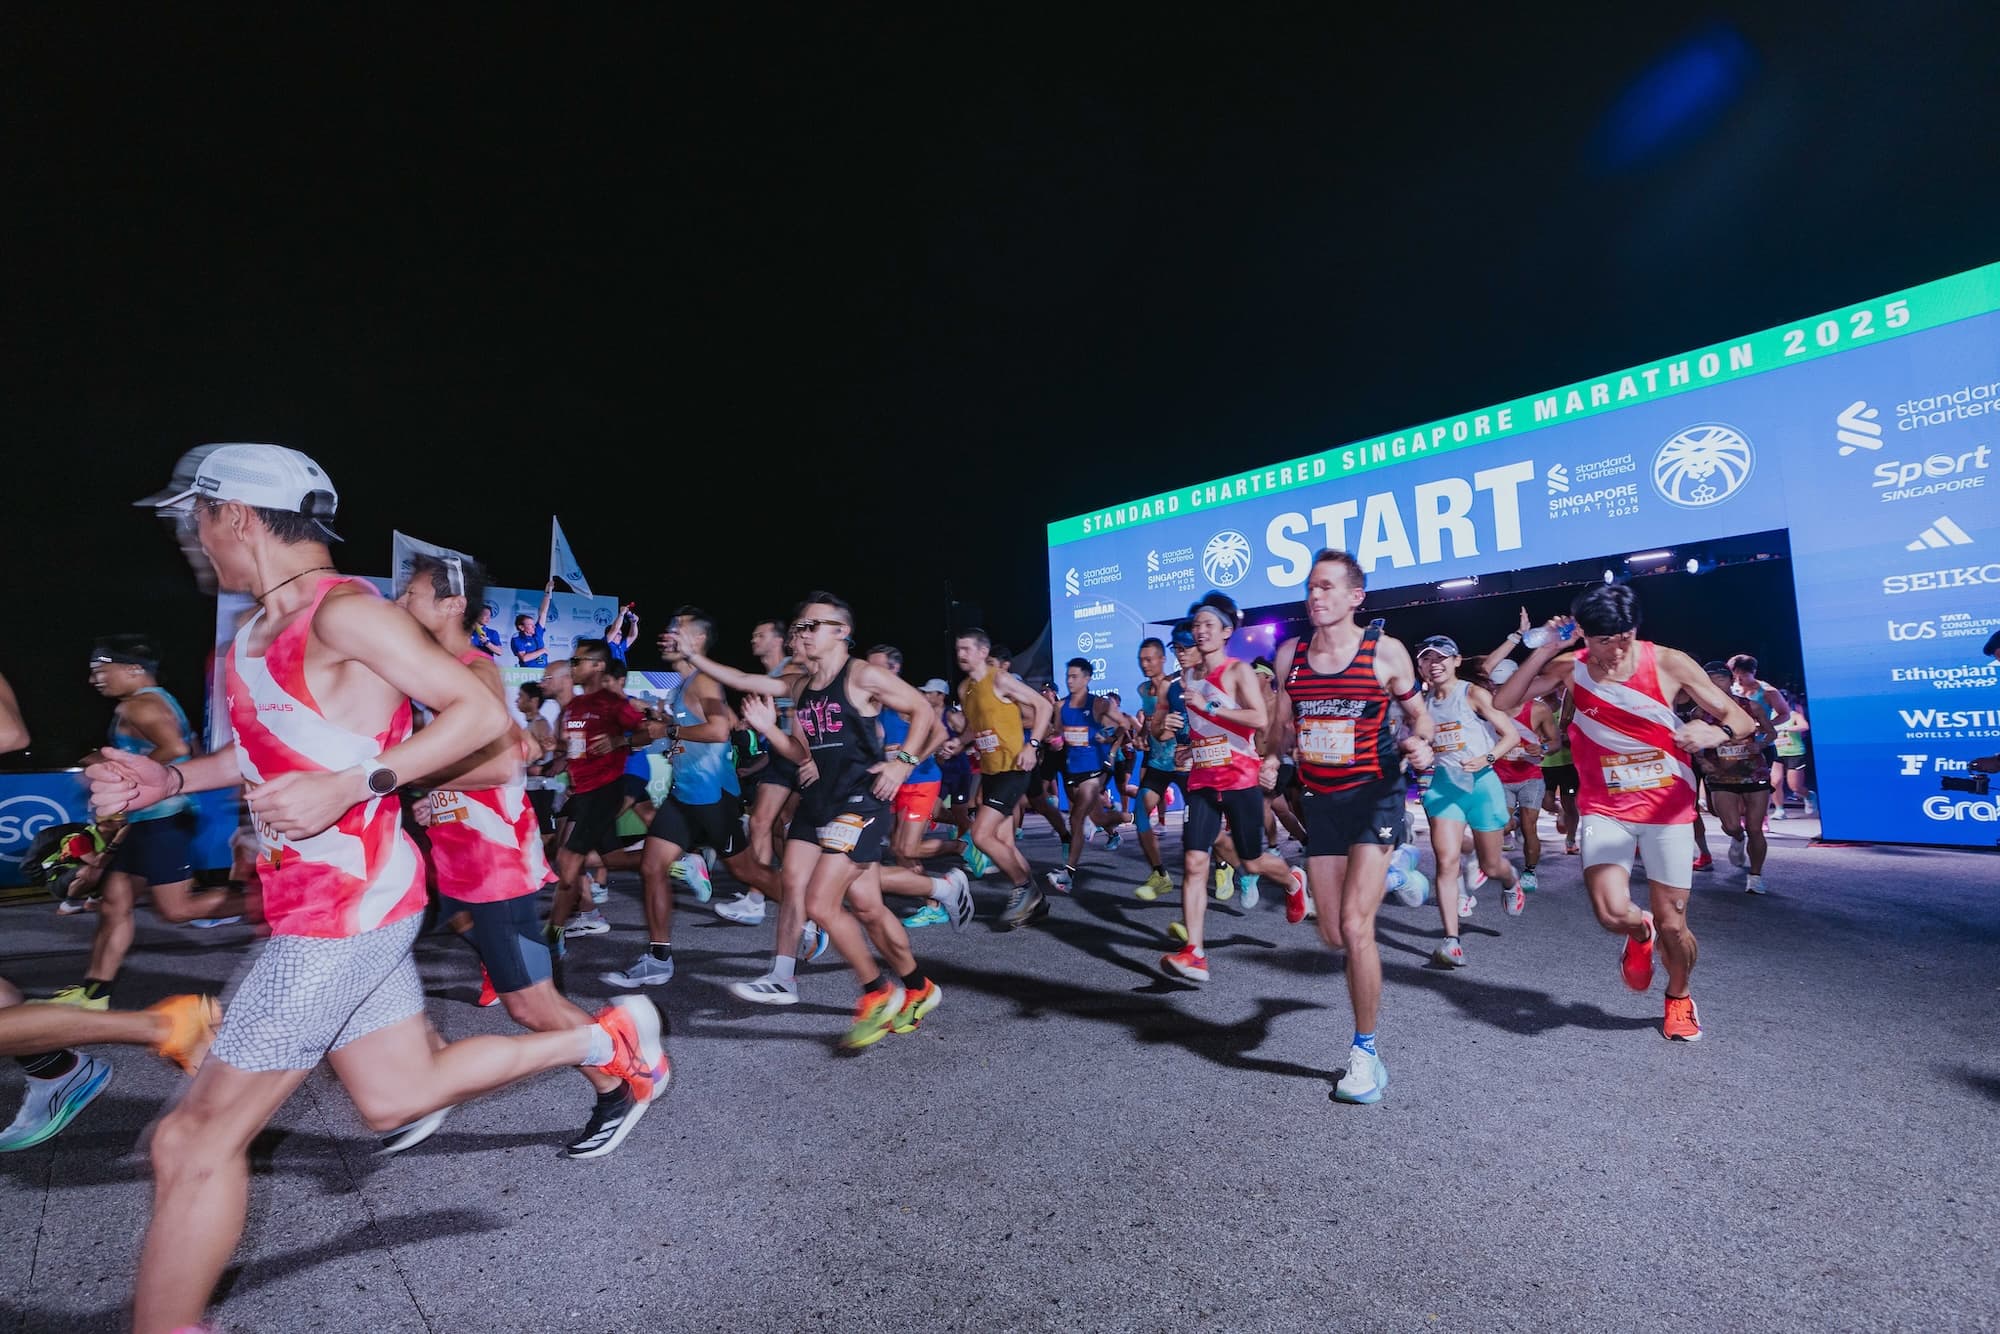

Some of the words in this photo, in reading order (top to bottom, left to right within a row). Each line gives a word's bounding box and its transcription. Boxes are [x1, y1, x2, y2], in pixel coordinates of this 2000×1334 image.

[1082, 493, 1180, 534] STANDARD
[1191, 458, 1328, 507] CHARTERED
[1342, 408, 1514, 471] SINGAPORE
[1533, 342, 1754, 423] MARATHON
[1783, 300, 1911, 357] 2025
[1575, 453, 1632, 474] standard
[1575, 462, 1636, 482] chartered
[1872, 444, 1991, 488] Sport
[1549, 483, 1638, 511] SINGAPORE
[1880, 475, 1985, 503] SINGAPORE
[1549, 496, 1639, 520] MARATHON
[1607, 504, 1640, 518] 2025
[1266, 460, 1535, 588] START
[1083, 564, 1119, 579] standard
[1083, 571, 1122, 588] chartered
[1147, 568, 1195, 585] SINGAPORE
[1939, 613, 1972, 622] TATA
[1887, 620, 1937, 641] tcs
[1941, 627, 1989, 638] SERVICES
[1891, 665, 1997, 682] Ethiopian
[1906, 731, 1951, 739] HOTELS
[1610, 763, 1664, 782] A1179
